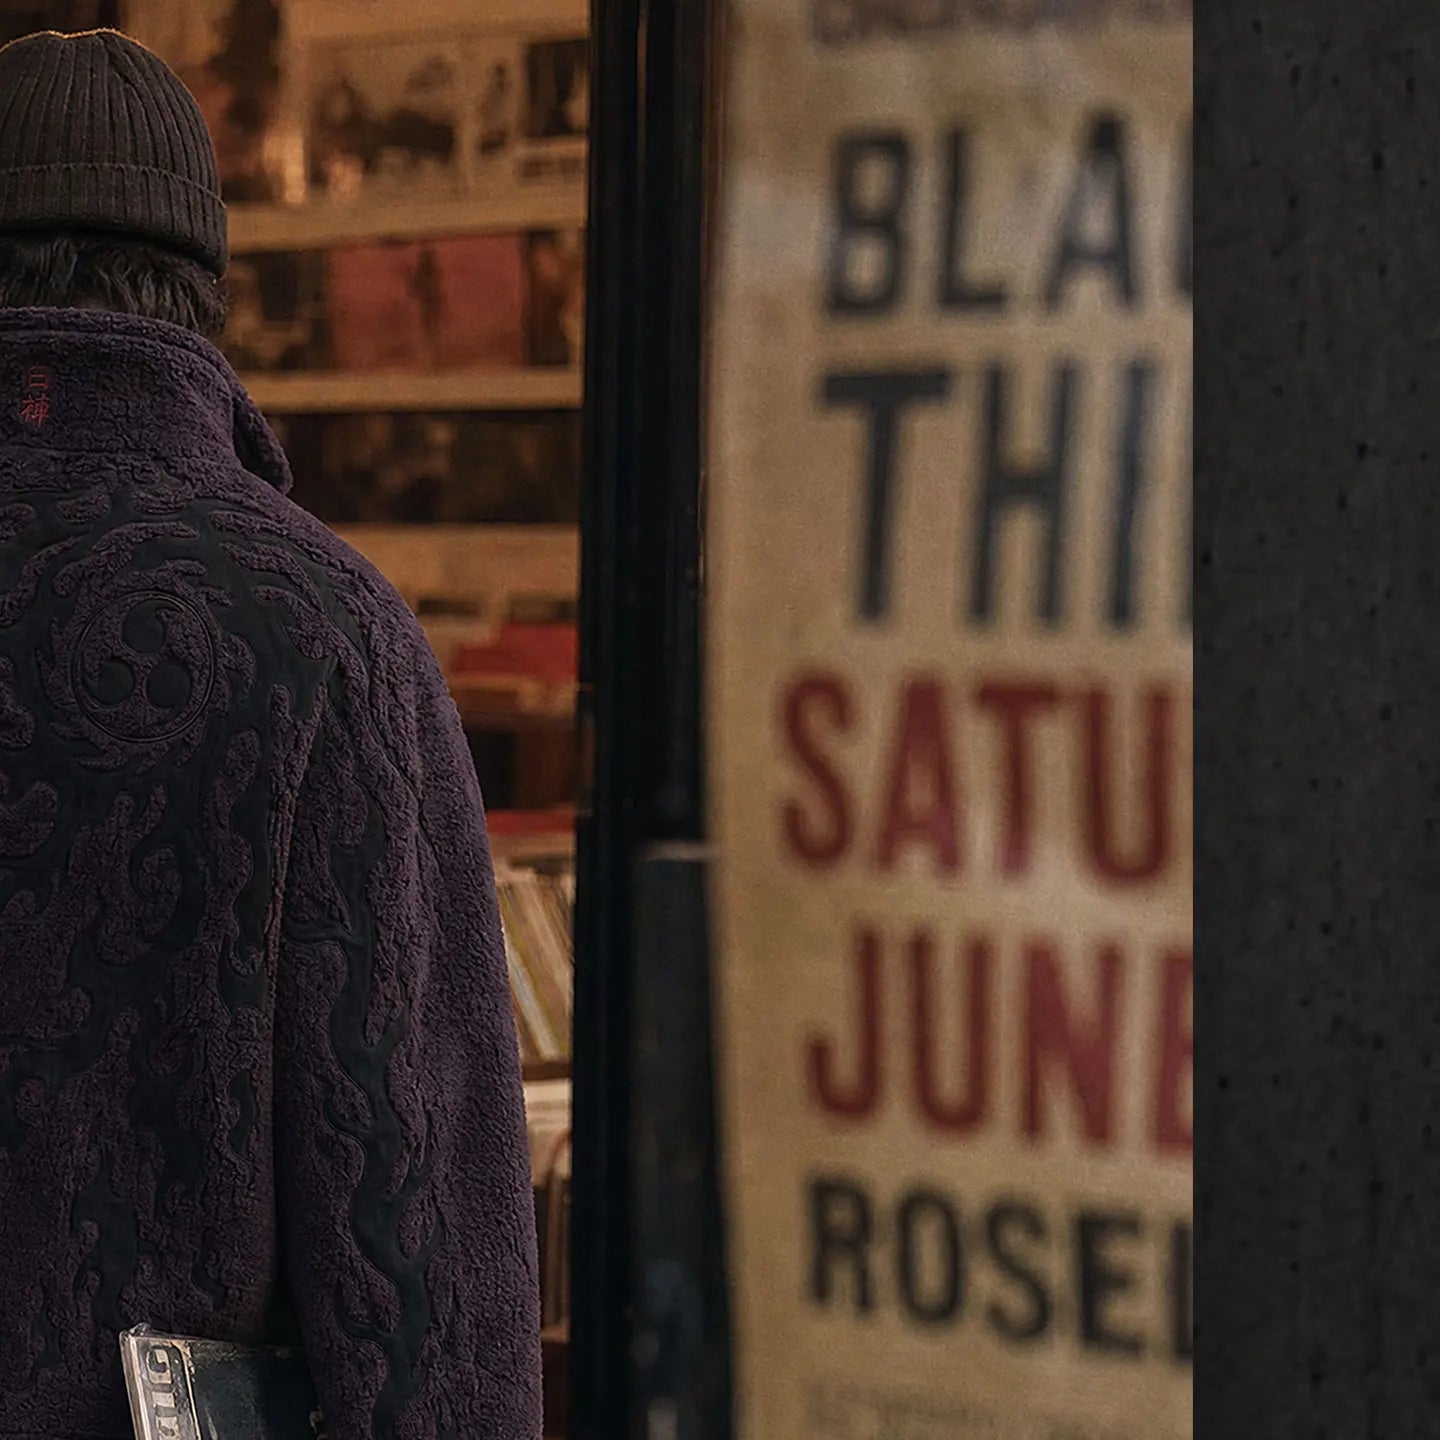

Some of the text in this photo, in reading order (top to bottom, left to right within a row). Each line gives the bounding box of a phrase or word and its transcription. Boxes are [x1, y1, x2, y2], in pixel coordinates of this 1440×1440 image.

[824, 107, 1193, 318] BLA
[816, 355, 1193, 629] THI
[776, 667, 1180, 885] SATU
